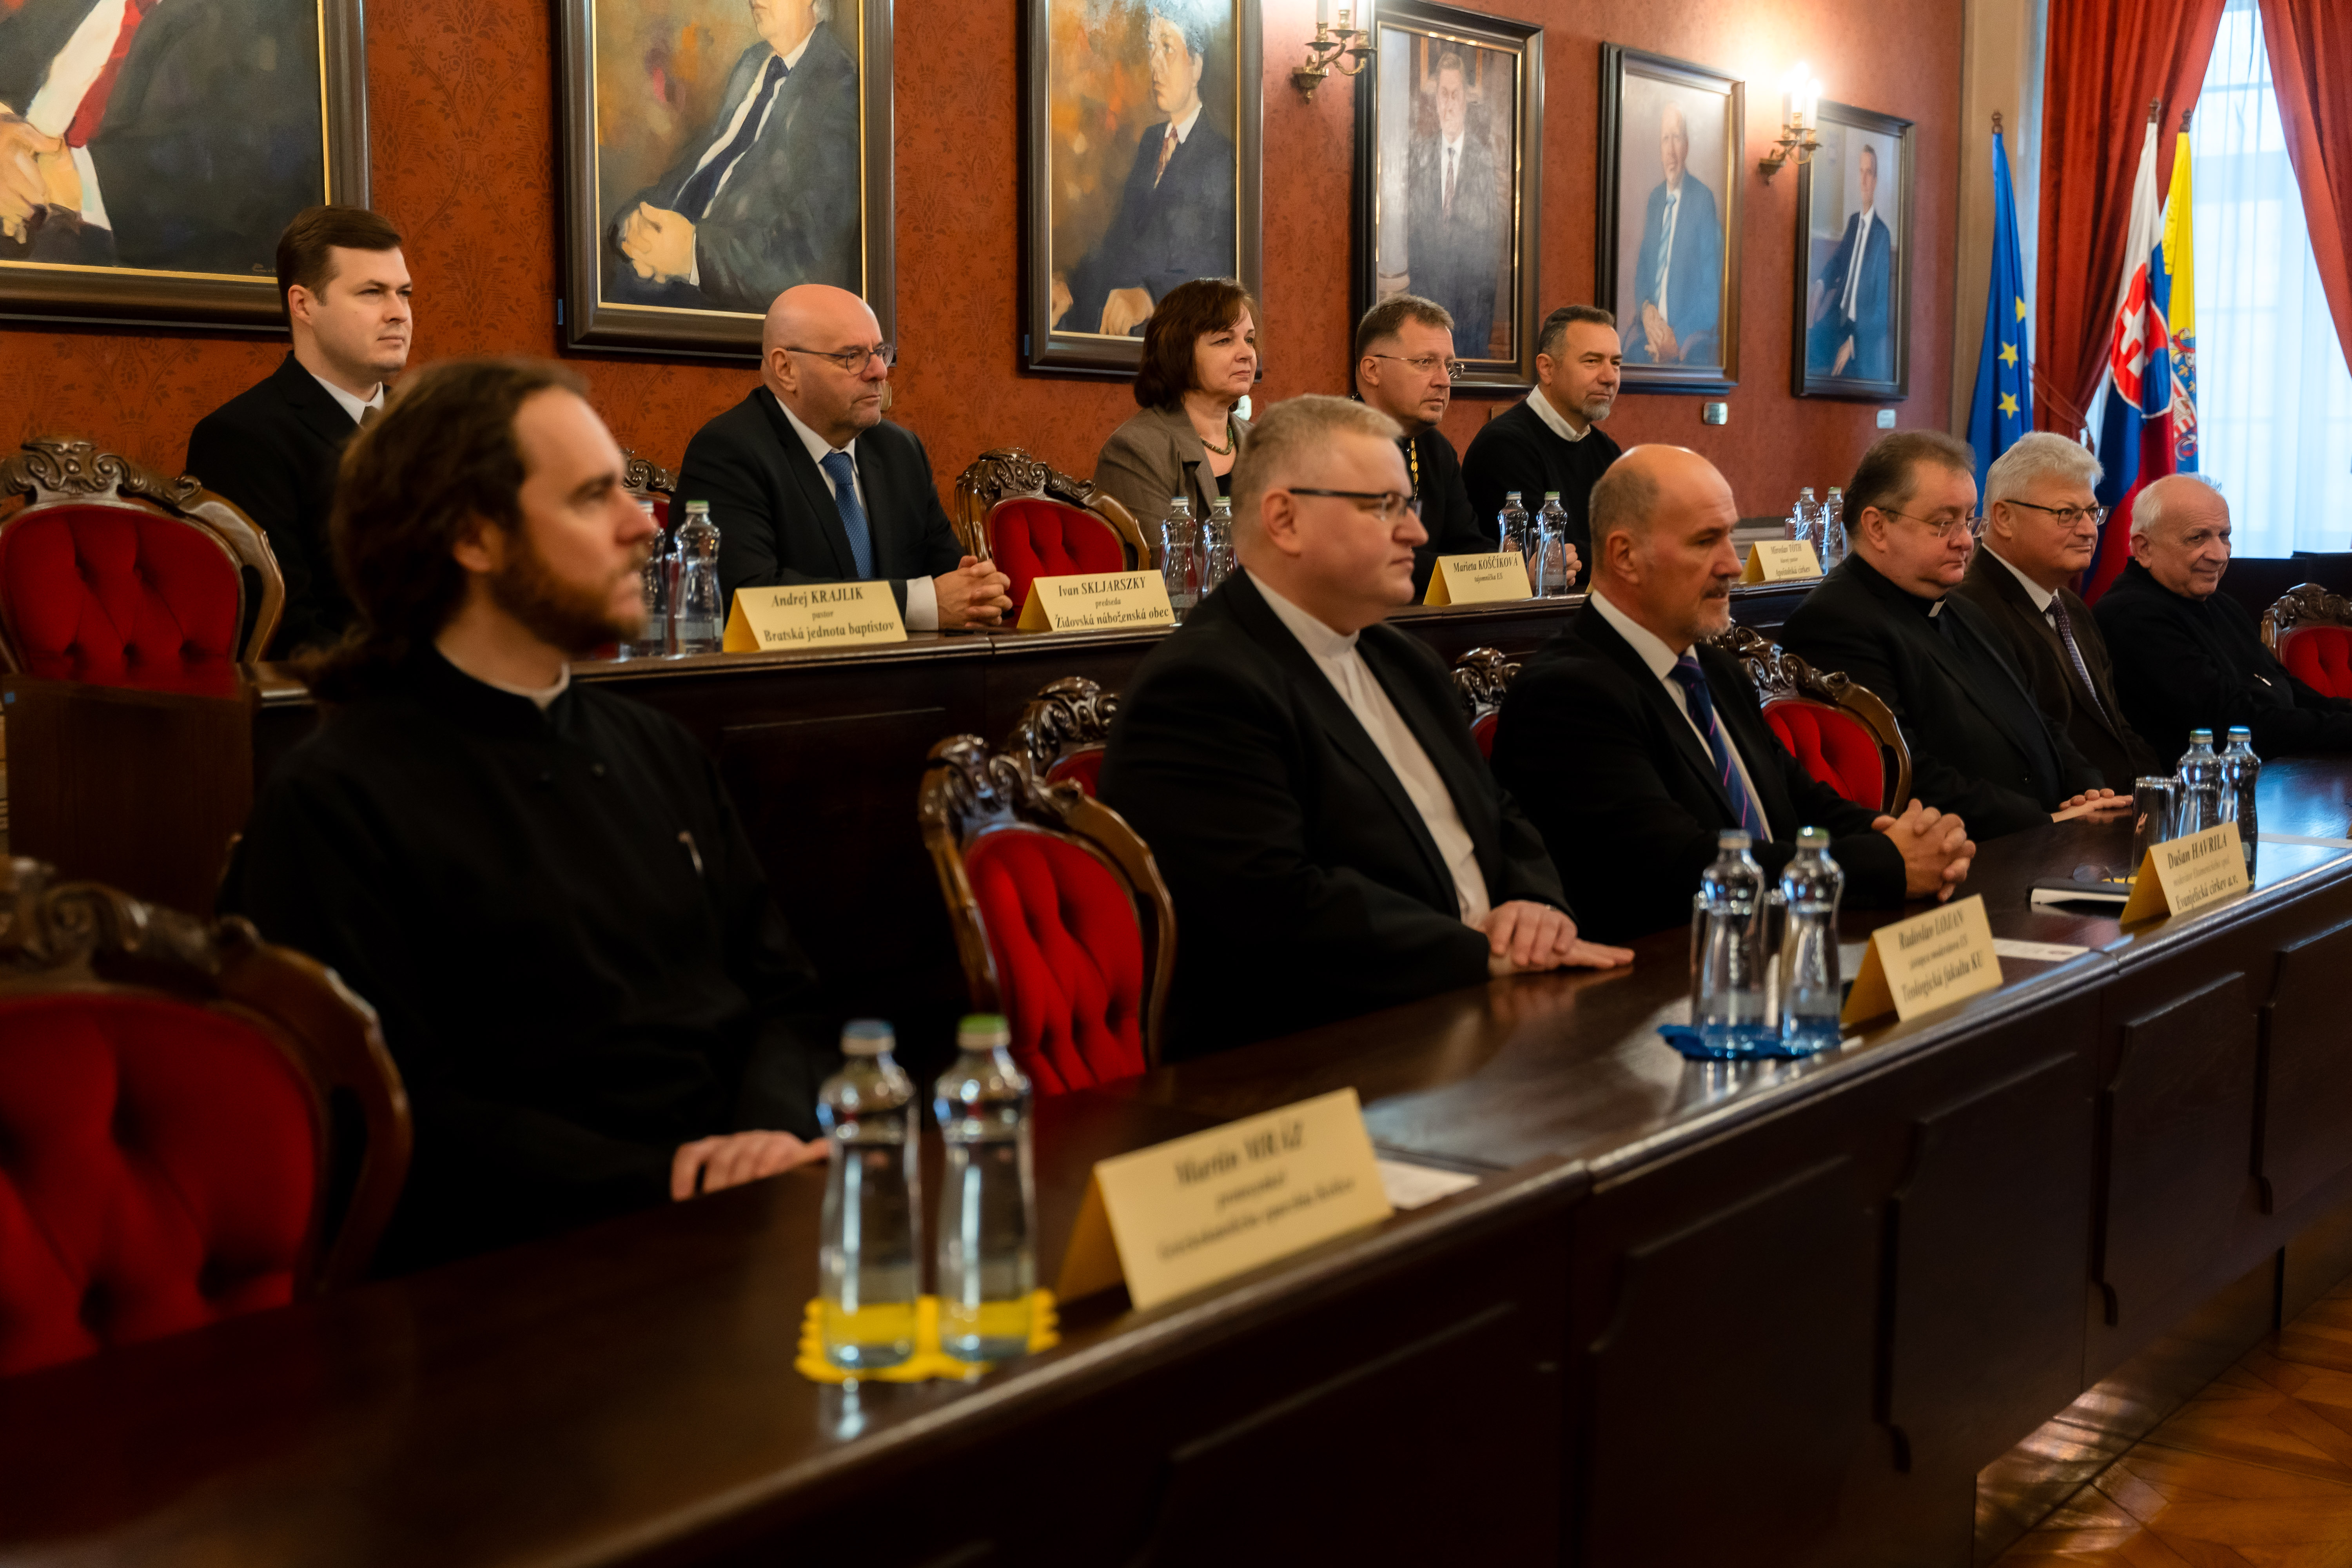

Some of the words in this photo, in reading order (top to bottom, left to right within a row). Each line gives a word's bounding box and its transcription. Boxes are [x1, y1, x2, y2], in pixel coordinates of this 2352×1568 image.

[1789, 542, 1802, 552] TÓTH
[1453, 561, 1477, 573] Marieta
[1059, 585, 1079, 597] Ivan
[1082, 576, 1146, 594] SKLJARSZKY
[771, 593, 808, 608] Andrej
[811, 587, 863, 604] KRAJLIK
[1095, 597, 1121, 609] predseda
[812, 610, 833, 621] pastor
[1055, 613, 1094, 628] Židovská
[1097, 608, 1146, 624] náboženská
[1149, 607, 1169, 618] obec
[764, 627, 804, 642] Bratská
[807, 624, 846, 642] jednota
[849, 621, 894, 637] baptistov
[2167, 849, 2190, 869] Dušan
[2192, 833, 2227, 860] HAVRILA
